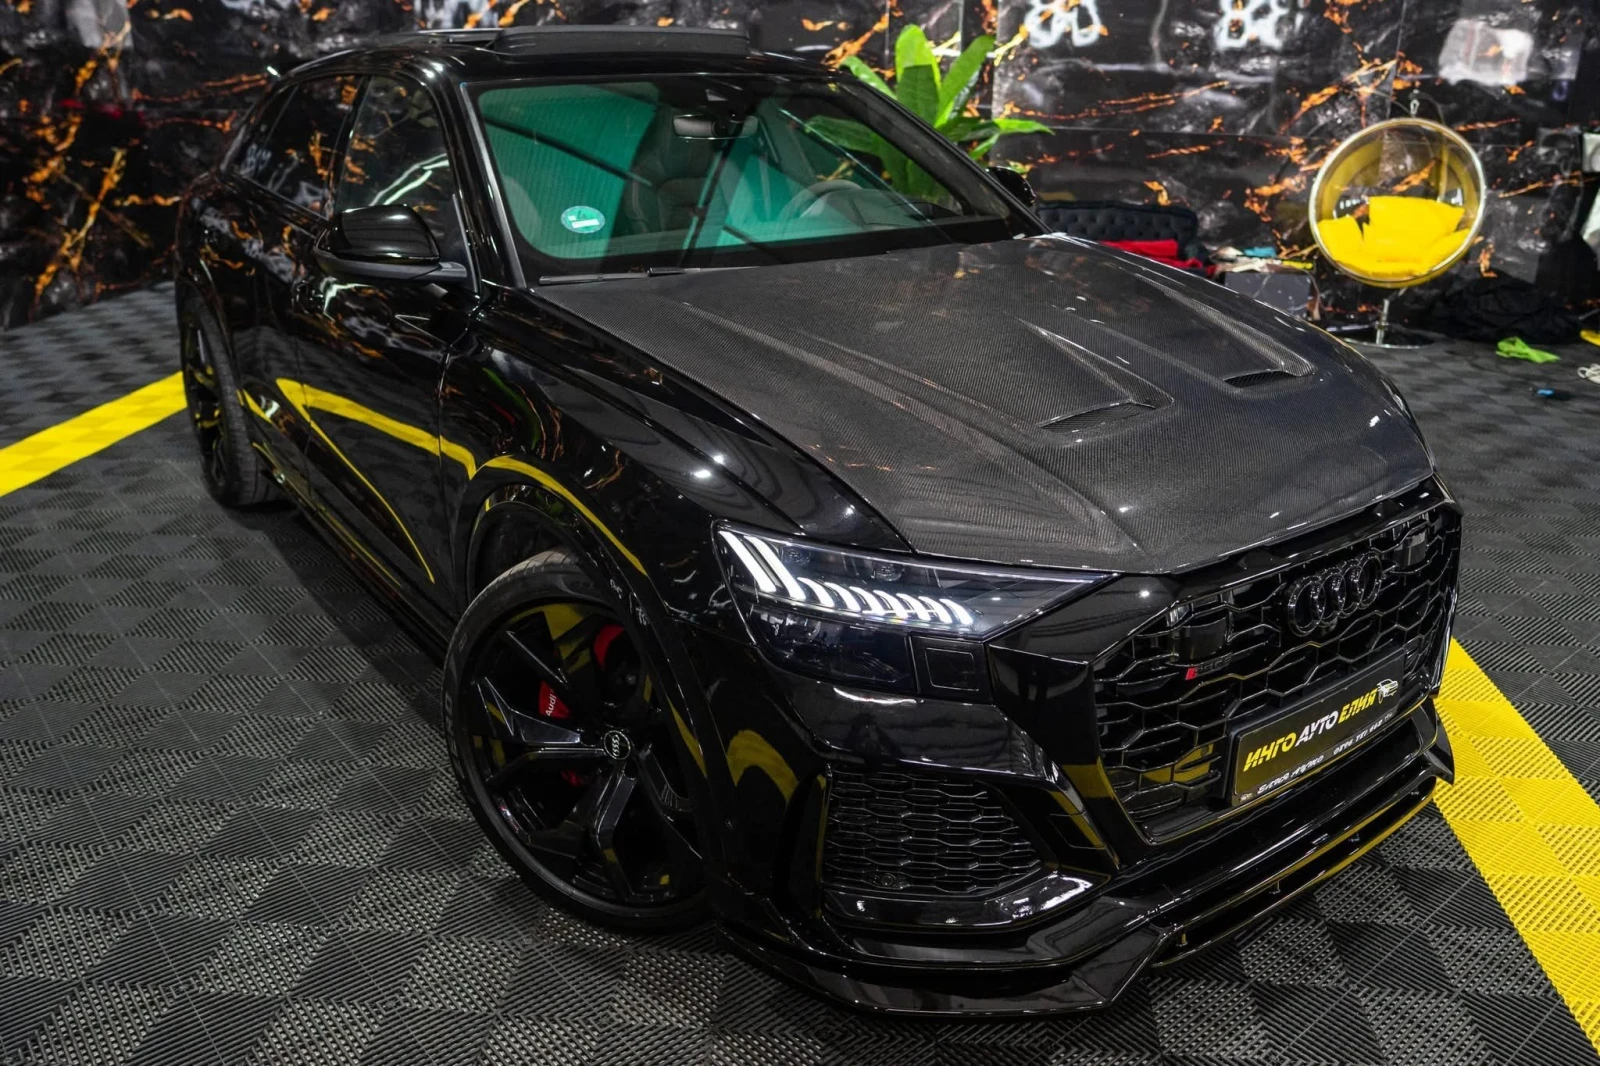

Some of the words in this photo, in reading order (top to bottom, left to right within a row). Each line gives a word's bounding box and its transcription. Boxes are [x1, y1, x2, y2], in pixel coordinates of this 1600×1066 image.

[545, 693, 557, 717] Audi
[1243, 732, 1297, 772] ИНГО
[1337, 688, 1378, 723] ЕЛИЯ
